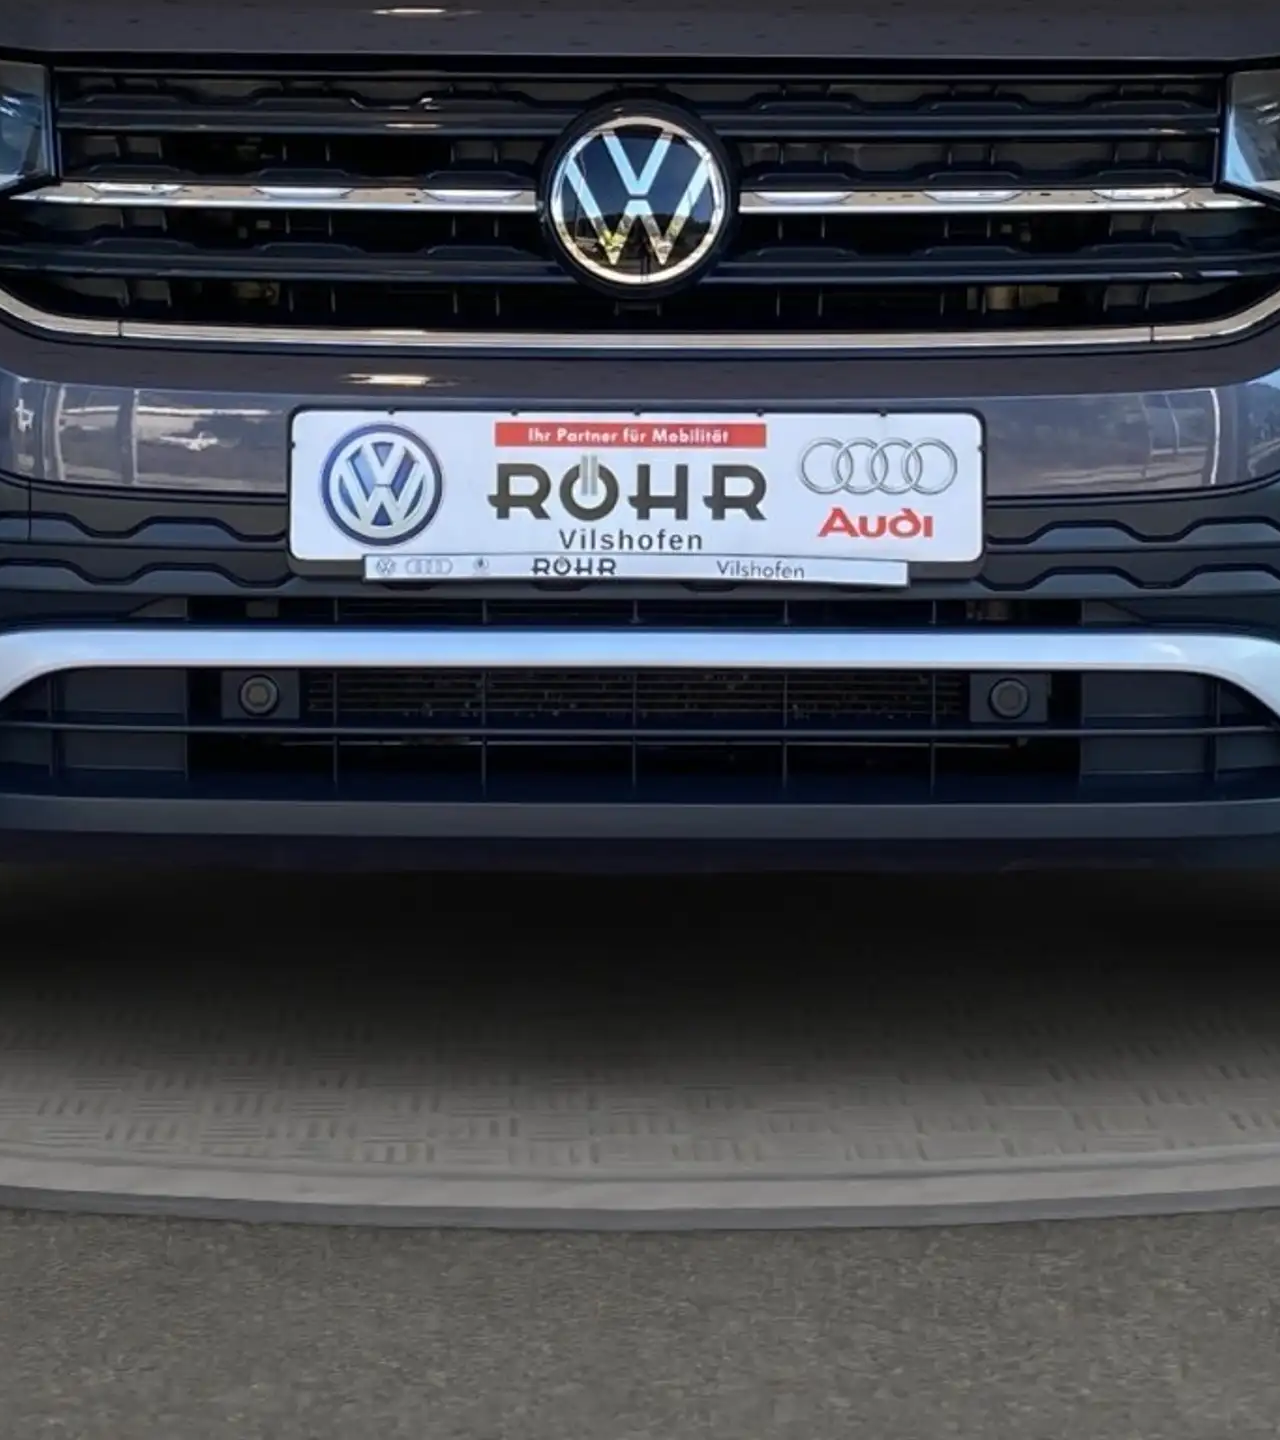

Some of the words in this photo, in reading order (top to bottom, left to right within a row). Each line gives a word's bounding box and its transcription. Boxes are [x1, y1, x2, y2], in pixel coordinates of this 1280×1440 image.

[563, 126, 714, 266] VW
[527, 427, 551, 443] Ihr
[556, 427, 618, 443] Partner
[622, 426, 647, 444] für
[651, 427, 729, 444] Mobilität
[817, 507, 934, 539] Audi
[558, 528, 703, 551] Vilshofen
[716, 559, 805, 580] Vilshofen
